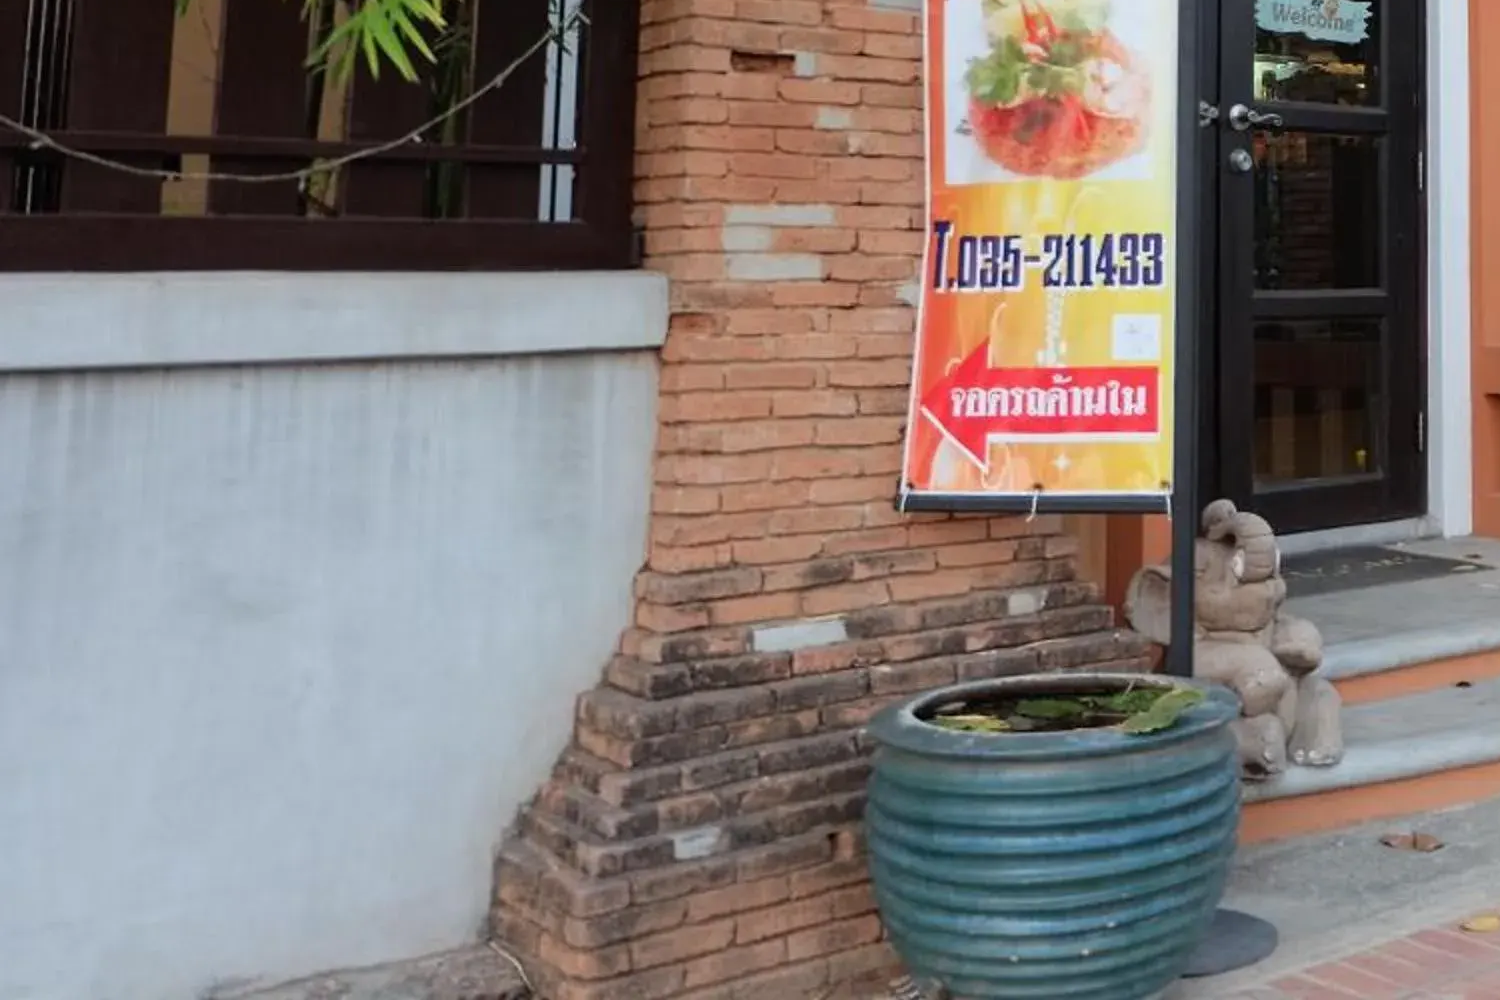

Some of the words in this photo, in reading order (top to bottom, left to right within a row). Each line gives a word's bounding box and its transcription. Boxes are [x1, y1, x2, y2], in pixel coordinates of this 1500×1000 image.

[1272, 1, 1356, 32] Welcome
[950, 373, 1147, 417] จอดรถด้านใน
